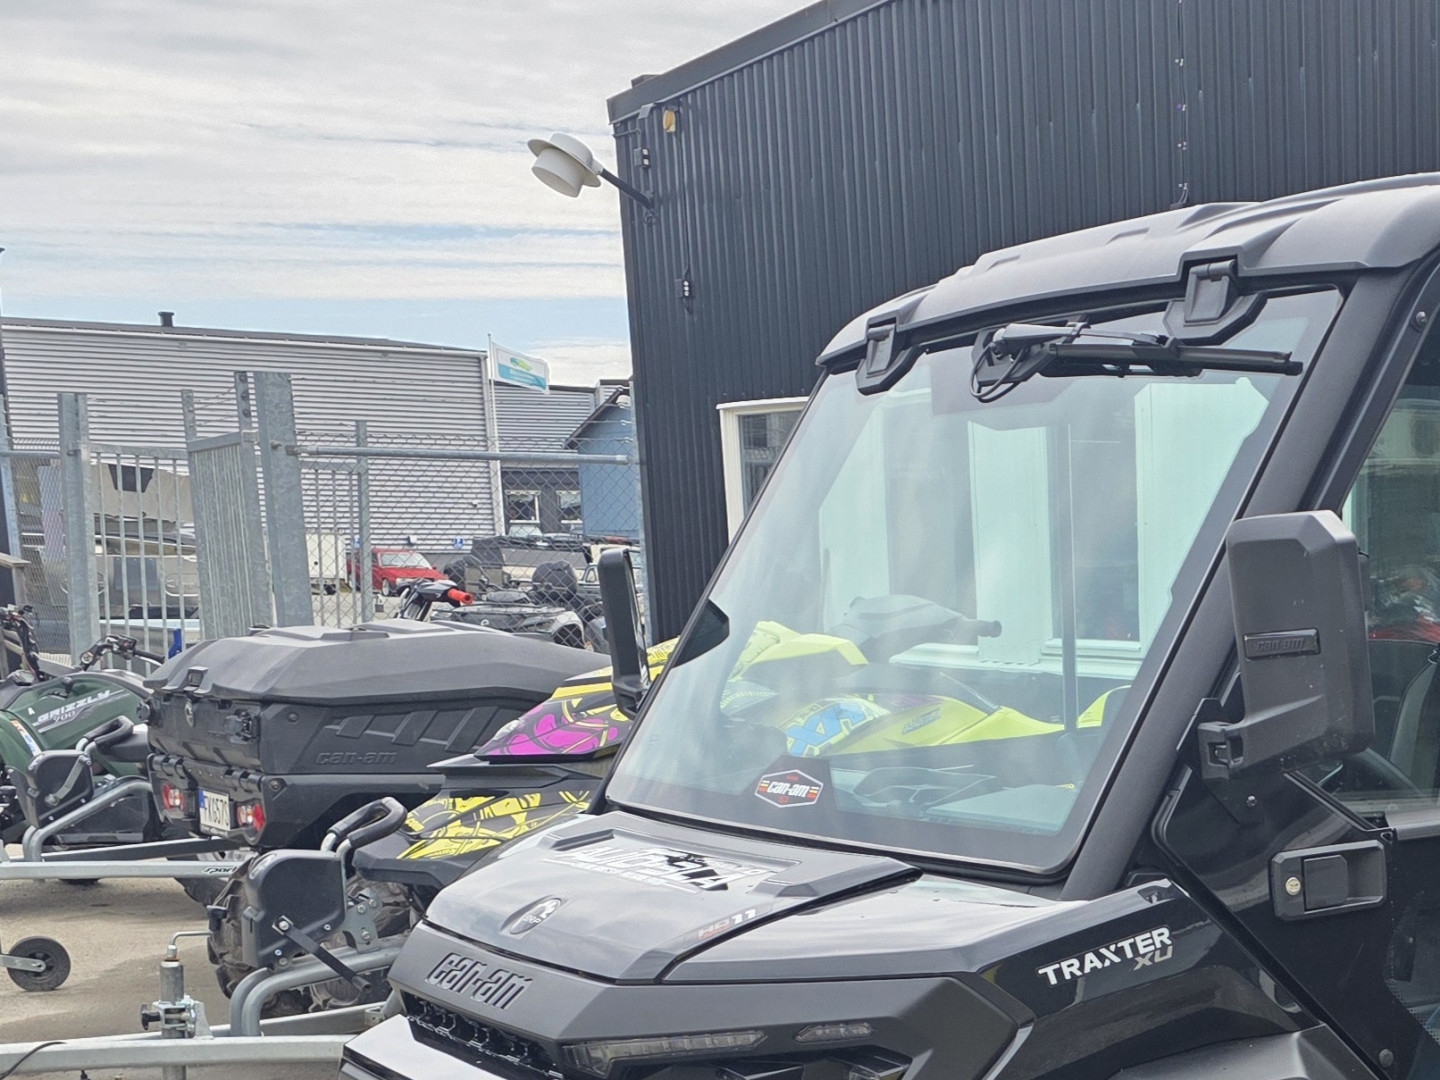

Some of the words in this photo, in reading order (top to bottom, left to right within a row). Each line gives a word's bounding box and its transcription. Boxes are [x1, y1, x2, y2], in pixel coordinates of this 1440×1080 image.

[38, 690, 110, 722] GRIZZLY
[53, 710, 76, 722] 700
[316, 752, 397, 765] can-am
[767, 782, 810, 797] can-am
[1037, 926, 1173, 986] TRAXTER
[424, 952, 533, 1010] can-am
